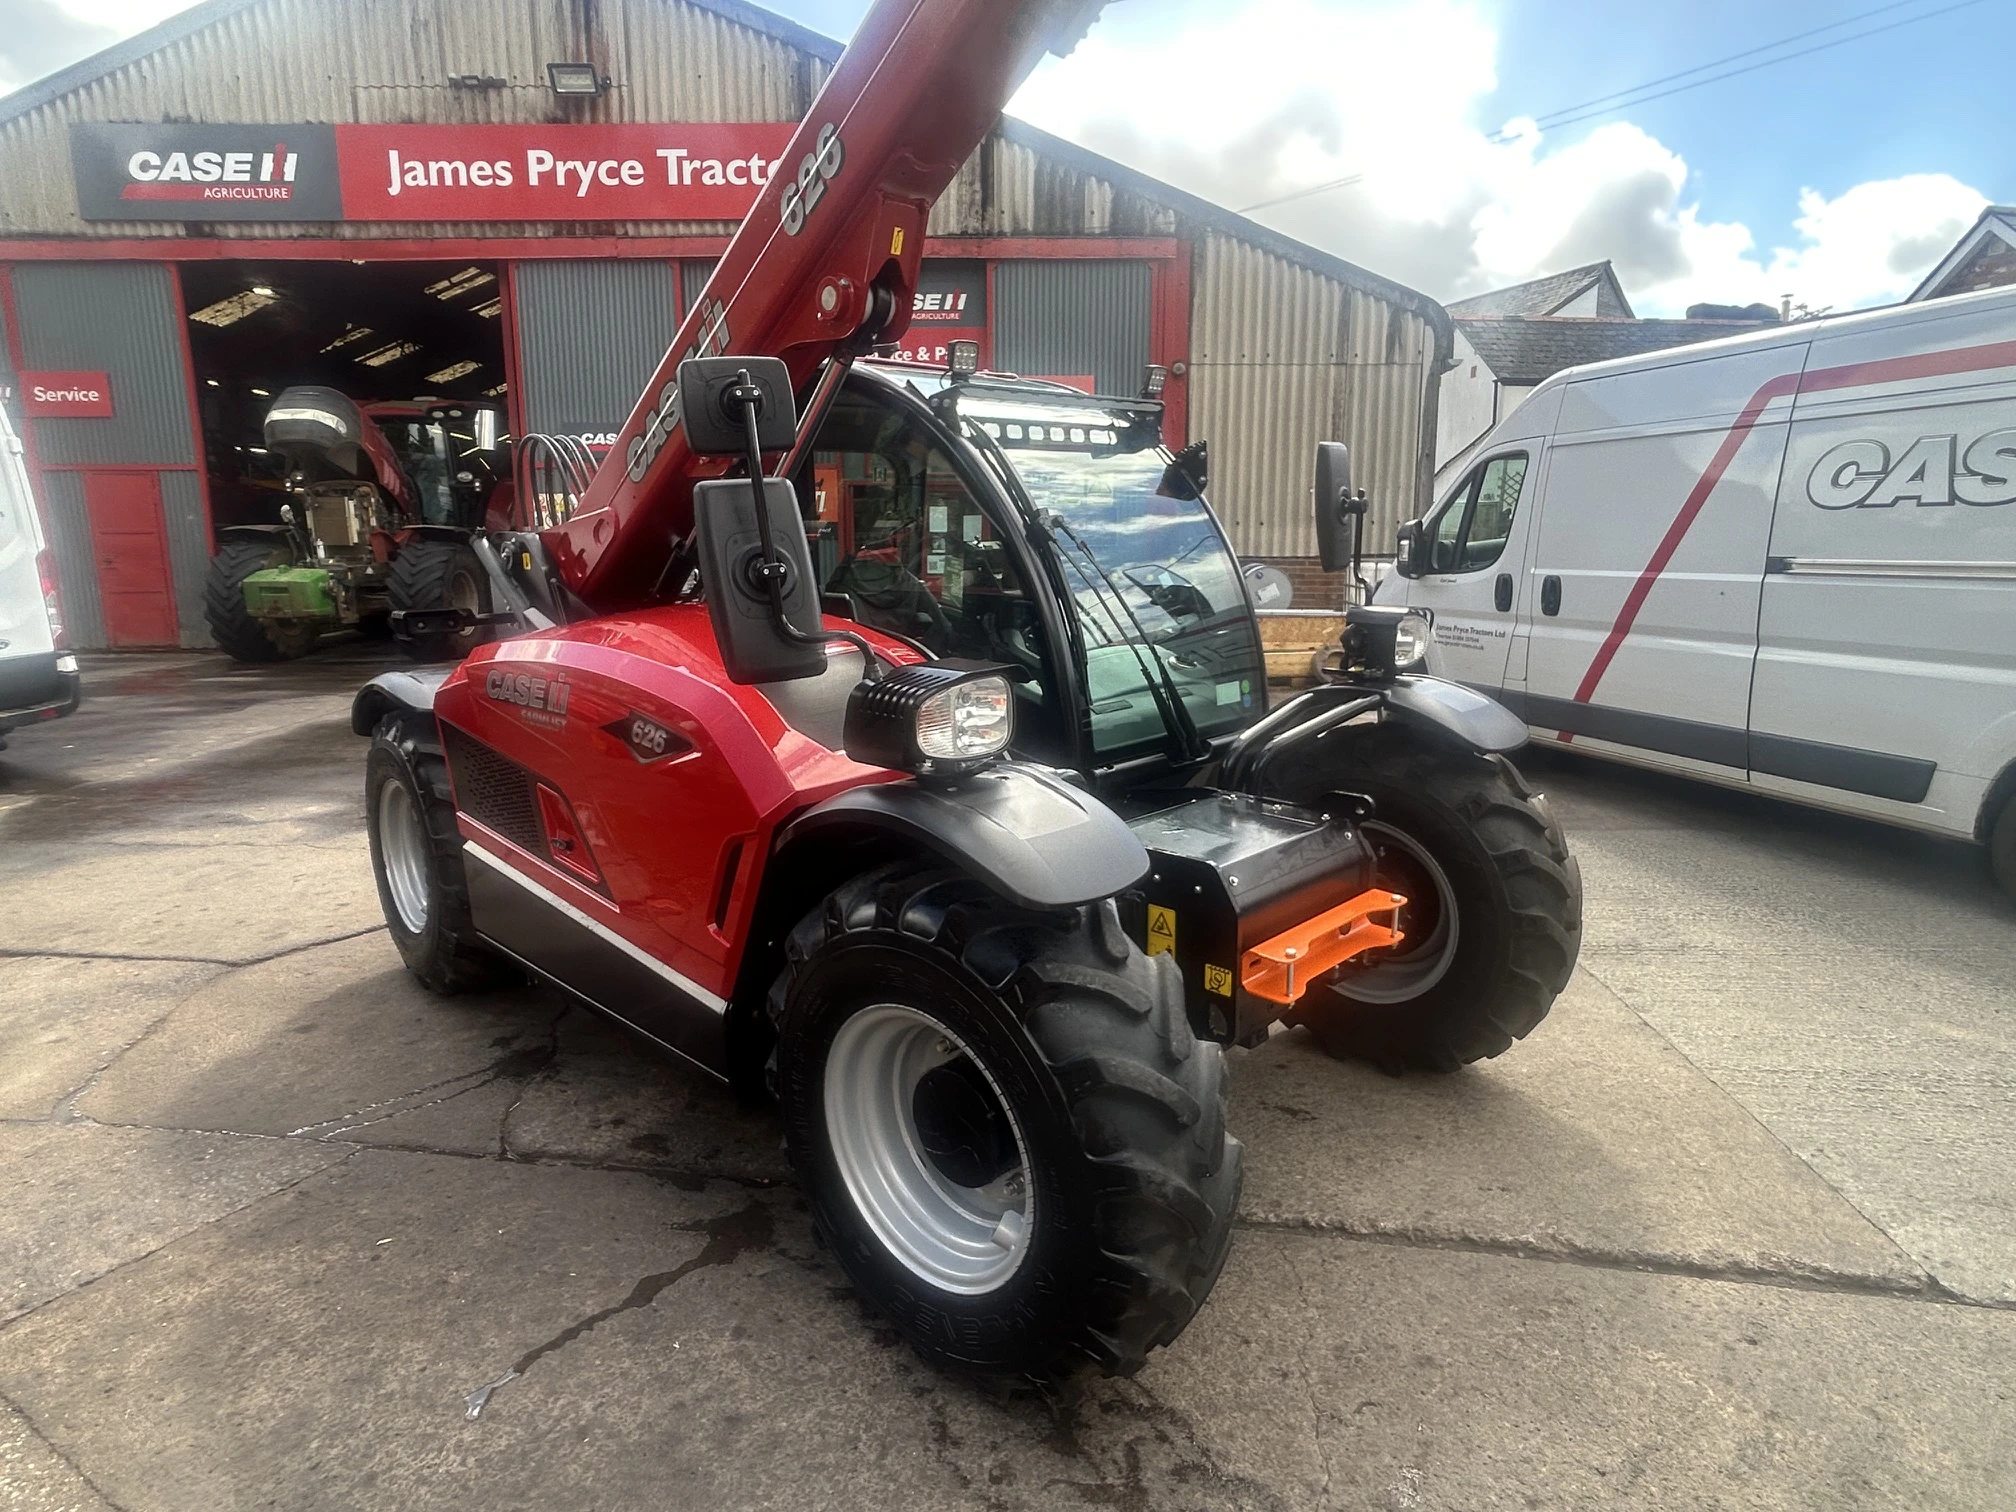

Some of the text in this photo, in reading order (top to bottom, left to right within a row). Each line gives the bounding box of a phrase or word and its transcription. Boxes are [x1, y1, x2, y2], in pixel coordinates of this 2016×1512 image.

[128, 151, 253, 182] CASE
[387, 149, 513, 196] James
[526, 149, 644, 198] Pryce
[780, 122, 844, 237] 626
[204, 188, 288, 199] AGRICULTURE
[911, 312, 960, 321] AGRICULTURE
[917, 346, 930, 361] &
[935, 347, 948, 361] P
[33, 386, 99, 402] Service
[1453, 625, 1469, 634] Pryce
[1470, 627, 1493, 636] Tractors
[1495, 630, 1506, 638] Ltd
[485, 669, 547, 710] CASE
[632, 719, 667, 754] 626
